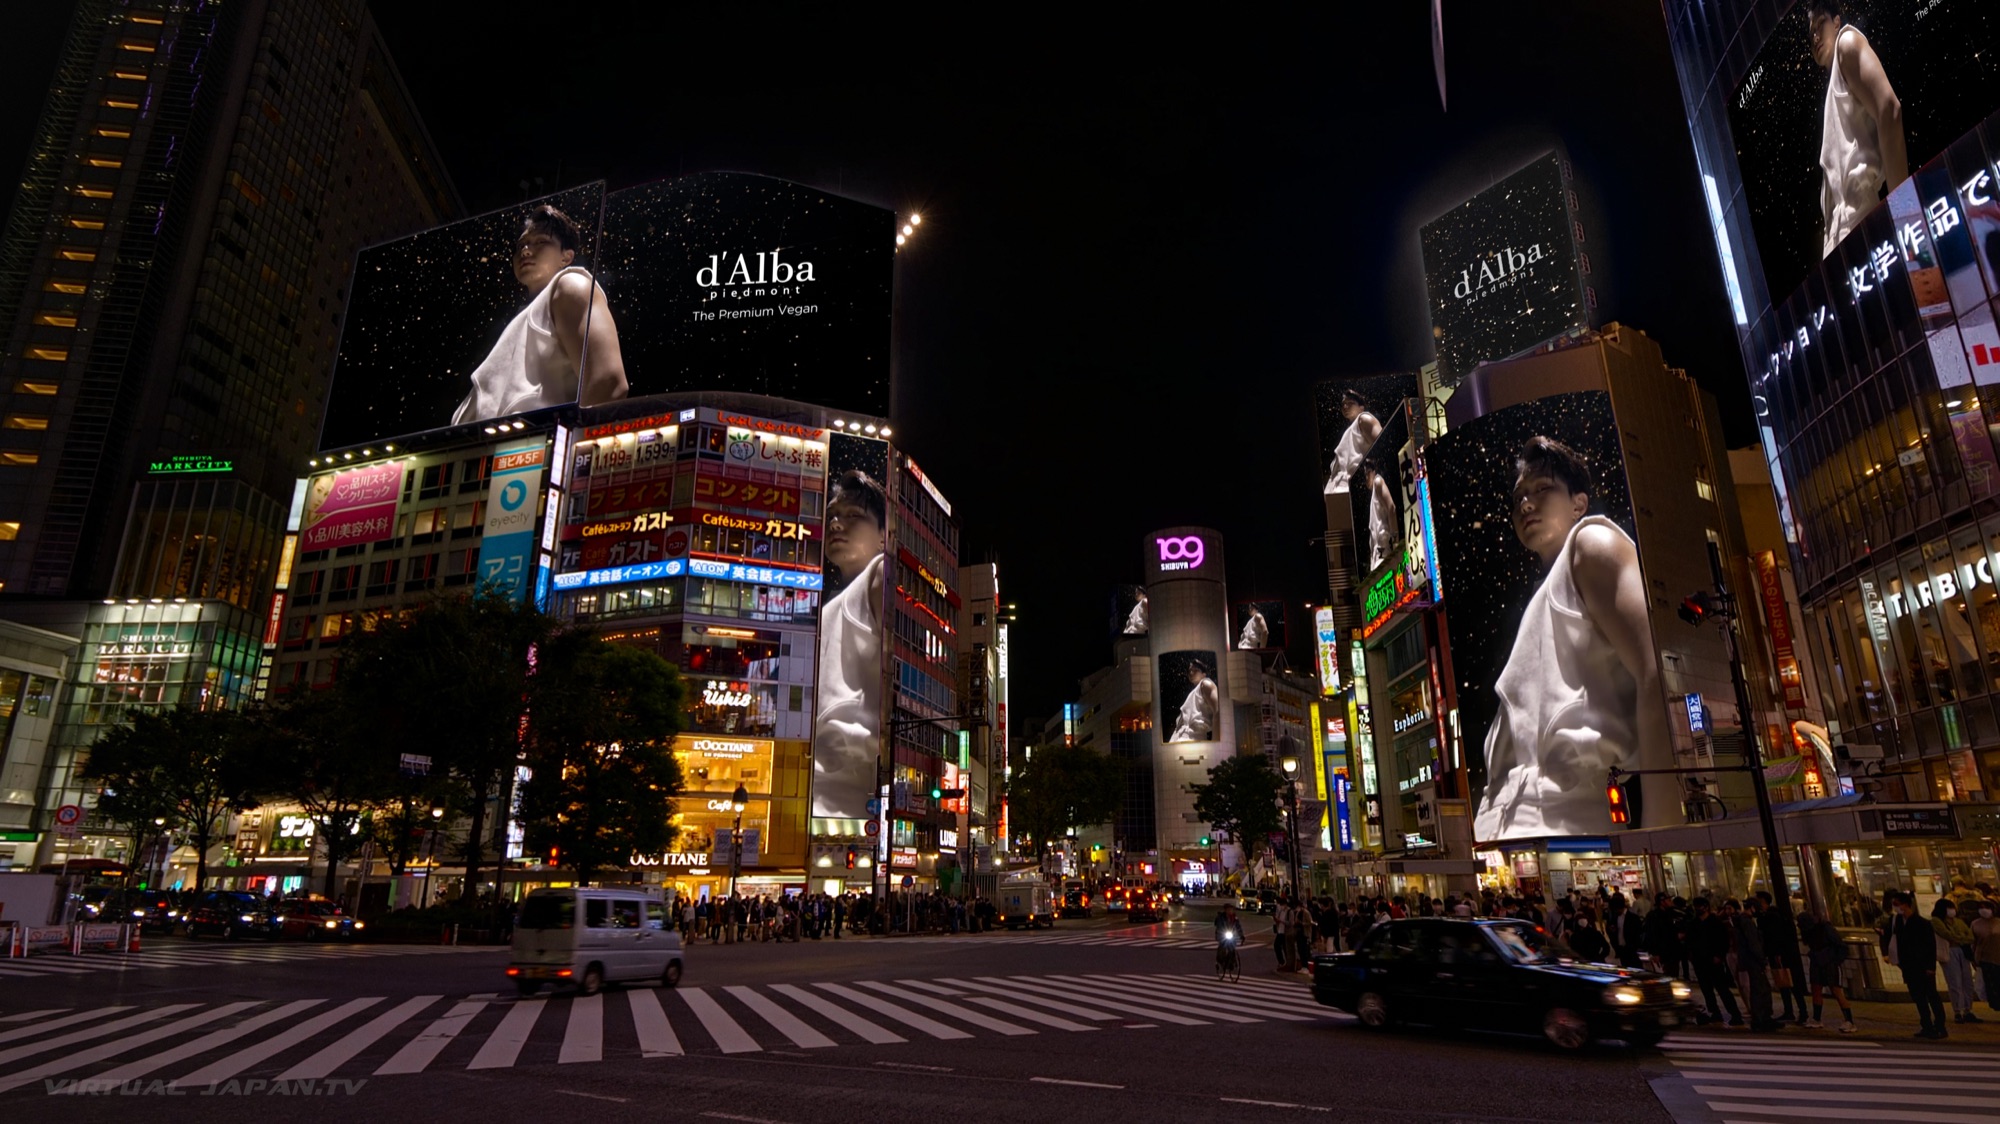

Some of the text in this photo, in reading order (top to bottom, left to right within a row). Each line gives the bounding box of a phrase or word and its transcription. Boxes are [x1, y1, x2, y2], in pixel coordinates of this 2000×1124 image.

[1740, 65, 1763, 108] d'Alba
[1846, 159, 2000, 299] 文学作品で
[696, 250, 815, 287] d'Alba
[1454, 244, 1543, 298] d'Alba
[710, 286, 800, 300] piedmont
[1466, 267, 1534, 306] piedmont
[693, 304, 818, 321] The Premium Vegan
[498, 451, 539, 469] 当ビル5F
[575, 453, 591, 467] 9F
[761, 442, 822, 468] しゃぶ葉
[150, 461, 232, 470] MARK CITY
[349, 471, 398, 489] 品川スキン
[348, 485, 390, 502] クリニック
[590, 481, 667, 509] プライス
[696, 476, 797, 508] コンタクト
[314, 517, 388, 543] 品川美容外科
[491, 511, 530, 529] eyecity
[582, 523, 603, 536] Café
[632, 511, 673, 531] ガスト
[702, 513, 729, 527] Café
[765, 520, 811, 540] ガスト
[563, 549, 580, 565] 7F
[608, 539, 658, 565] ガスト
[1156, 535, 1204, 569] 109
[589, 564, 662, 583] 英会話イーオン
[694, 562, 725, 574] AEON
[732, 565, 821, 587] 英会話イーオン
[1161, 561, 1189, 571] SHIBUYA
[1864, 582, 1878, 599] BIC
[1880, 552, 2000, 624] TARBUC
[703, 690, 752, 707] Ushi8
[1394, 709, 1425, 733] Euphoria
[693, 740, 754, 753] L'OCCITANE
[708, 799, 732, 812] Café
